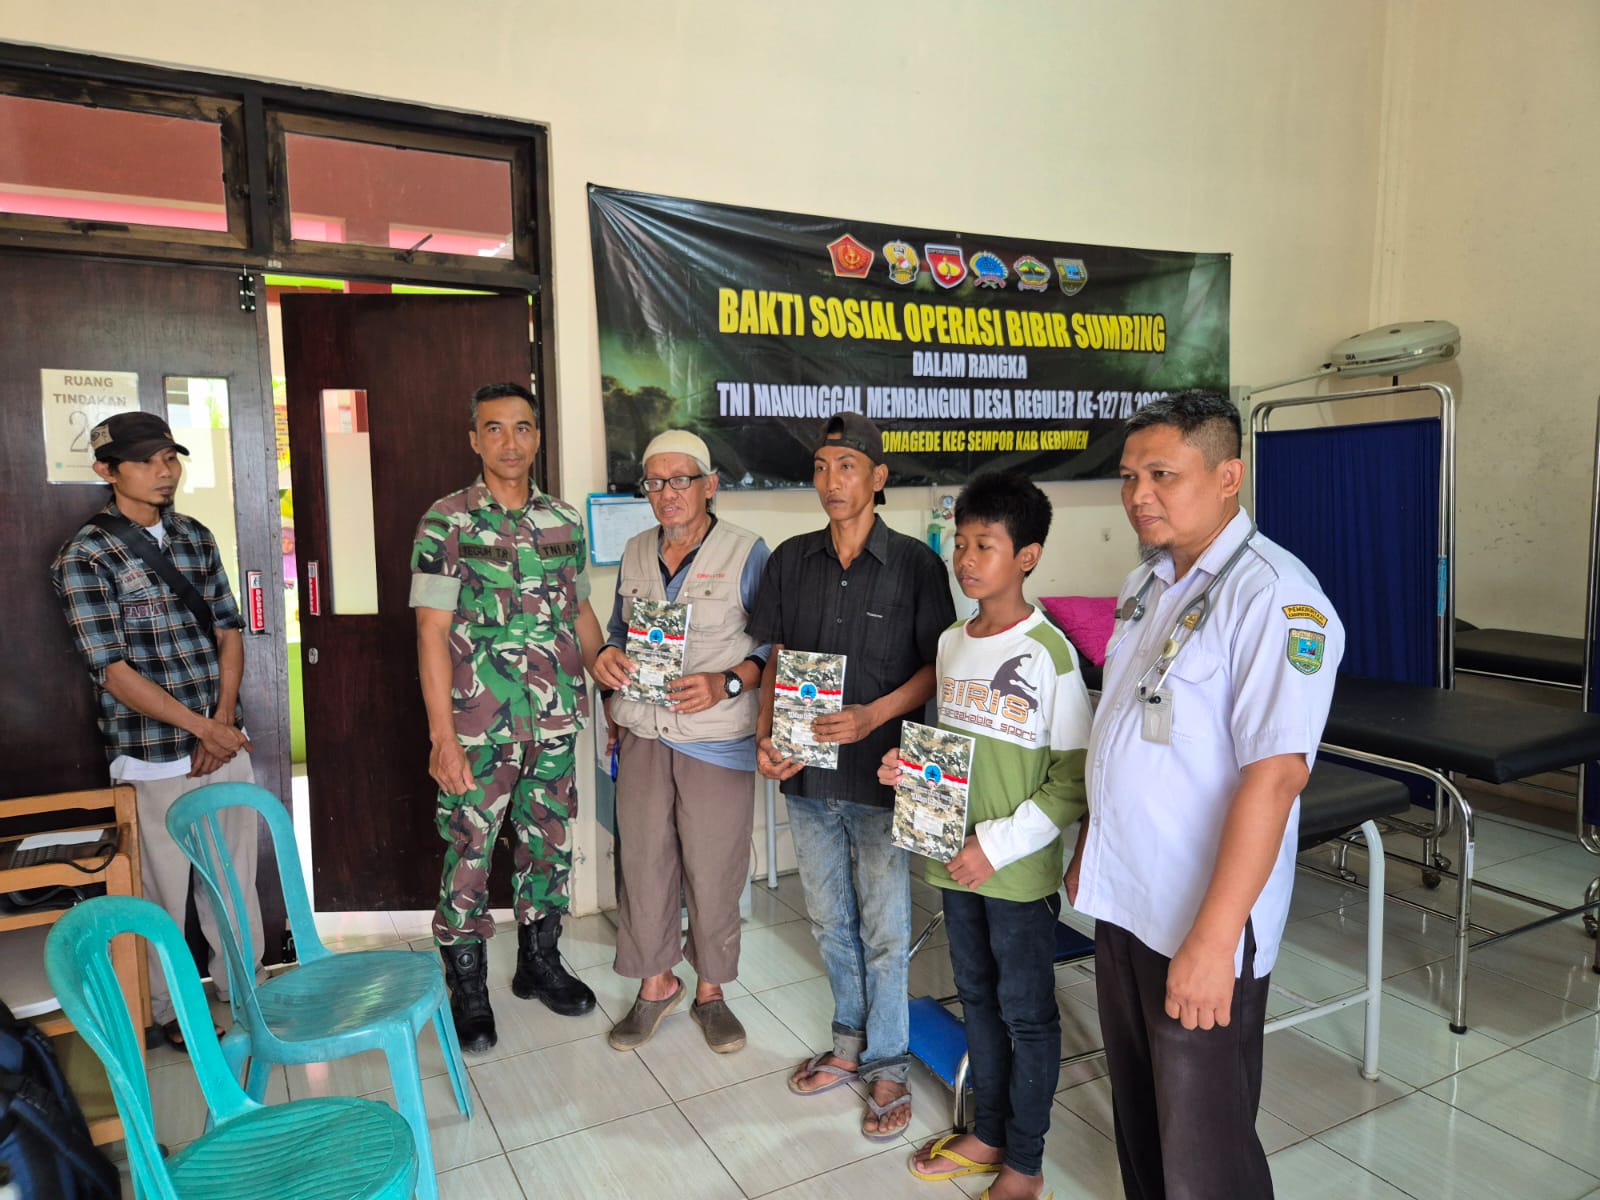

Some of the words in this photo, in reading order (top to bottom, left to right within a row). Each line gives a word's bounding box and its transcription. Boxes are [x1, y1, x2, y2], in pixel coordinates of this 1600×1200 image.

[718, 287, 805, 336] BAKTI
[809, 295, 902, 341] SOSIAL
[904, 303, 1004, 346] OPERASI
[1005, 310, 1072, 348] BIBIR
[1071, 313, 1166, 352] SUMBING
[912, 351, 966, 378] DALAM
[968, 353, 1028, 379] RANGKA
[64, 375, 113, 387] RUANG
[53, 393, 127, 406] TINDAKAN
[717, 382, 750, 417] TNI
[753, 383, 863, 418] MANUNGGAL
[867, 386, 971, 419] MEMBANGUN
[973, 389, 1013, 419] DESA
[1014, 390, 1074, 419] REGULER
[1076, 391, 1119, 419] KE-127
[1119, 391, 1132, 419] TA
[1134, 391, 1168, 411] 20
[882, 430, 940, 453] OMAGEDE
[943, 431, 966, 452] KEC
[967, 431, 1014, 452] SEMPOR
[1015, 431, 1039, 451] KAB
[1040, 430, 1089, 450] KEBUMEN
